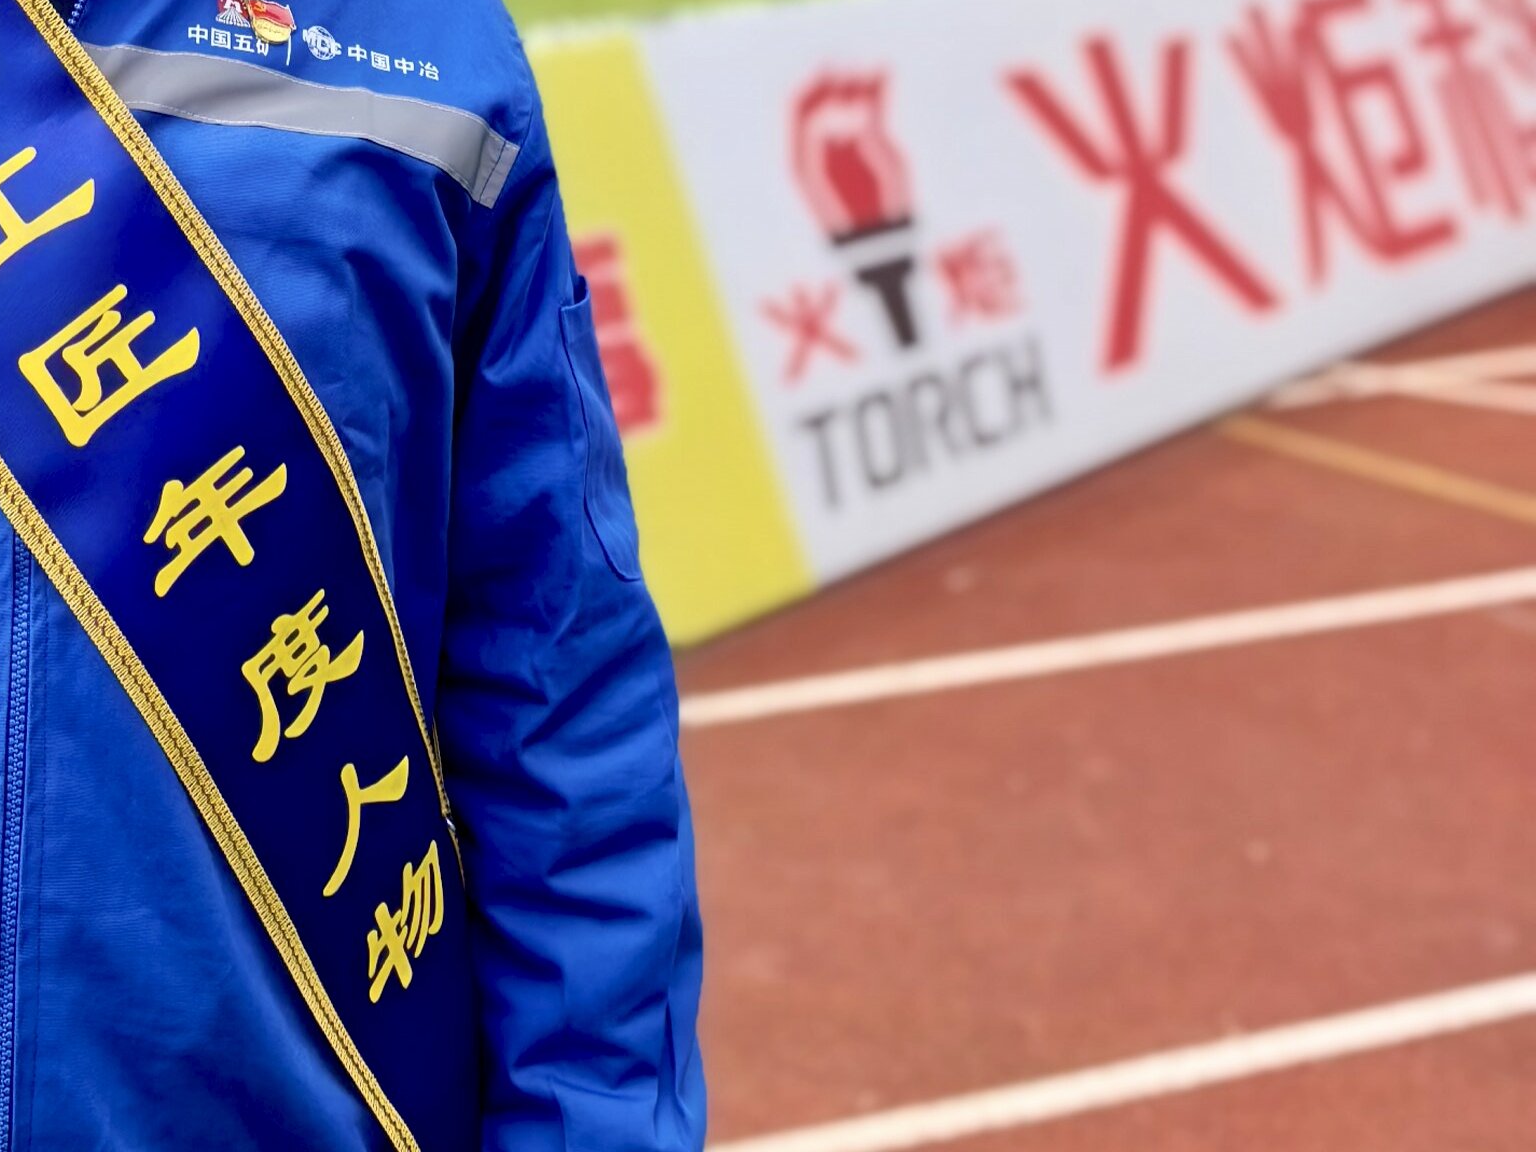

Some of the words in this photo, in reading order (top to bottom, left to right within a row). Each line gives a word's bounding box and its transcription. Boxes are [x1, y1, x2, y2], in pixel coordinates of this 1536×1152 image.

[347, 43, 440, 81] 中国中冶
[796, 330, 1058, 510] TORCH
